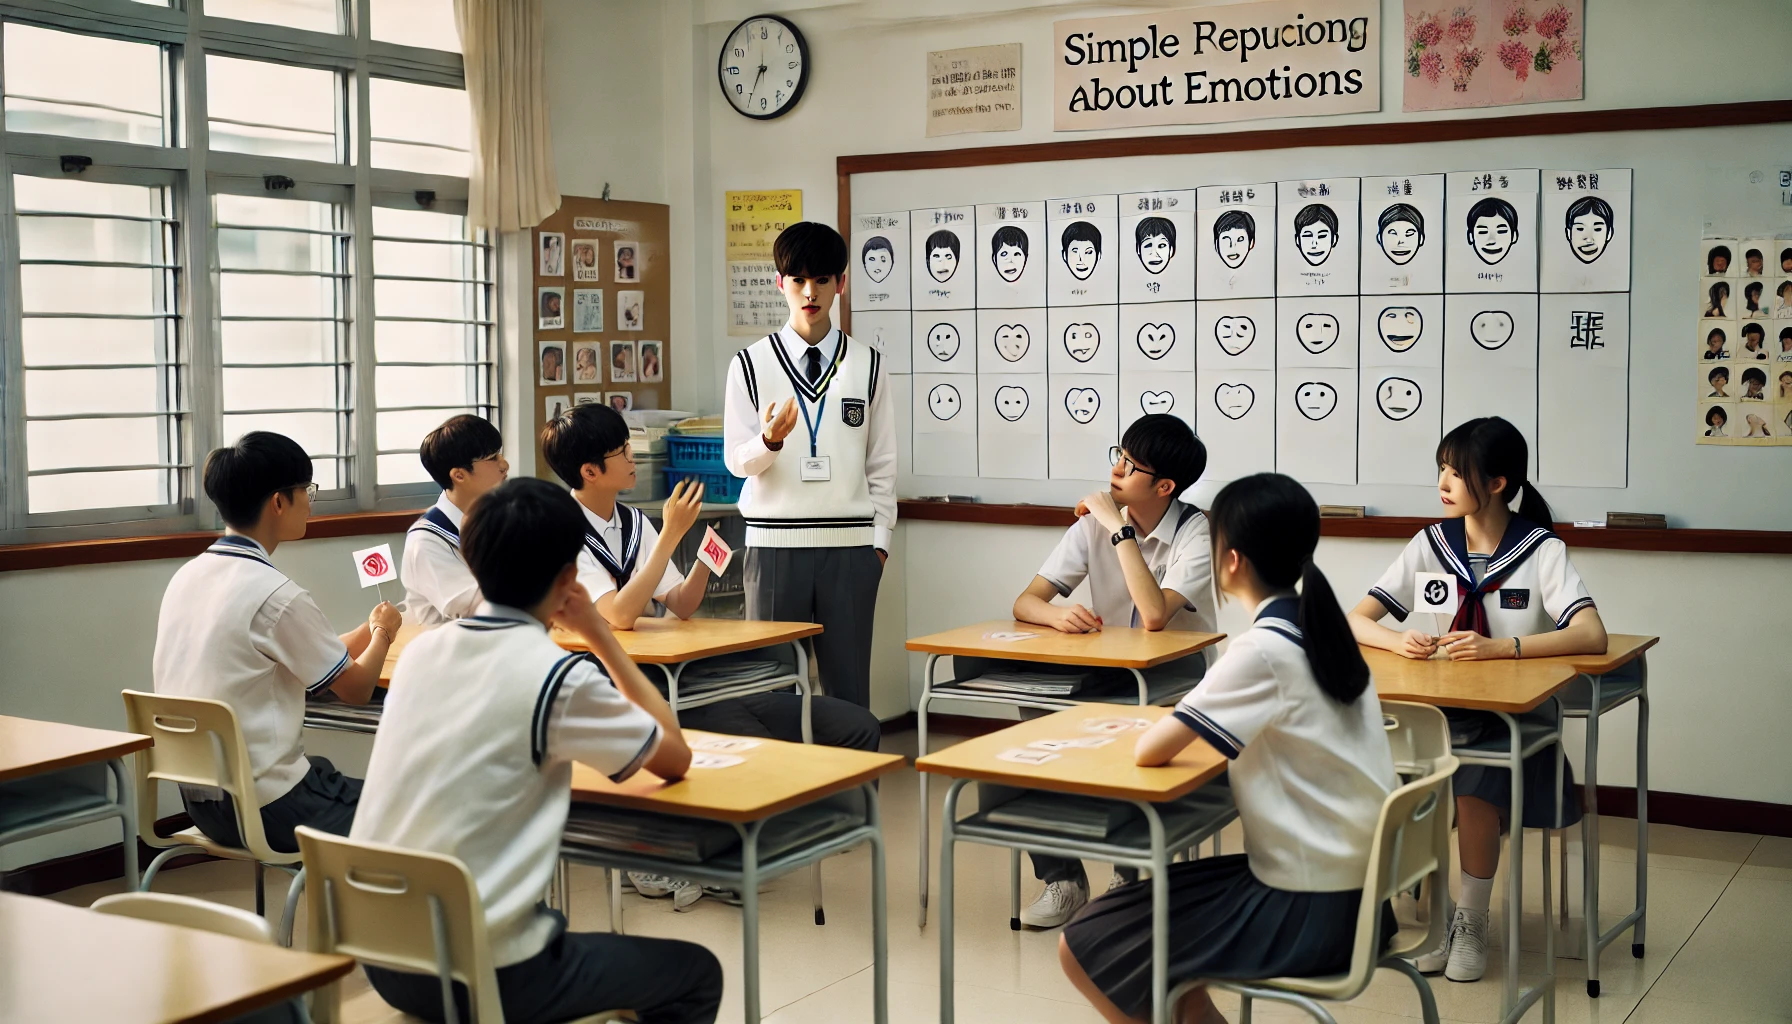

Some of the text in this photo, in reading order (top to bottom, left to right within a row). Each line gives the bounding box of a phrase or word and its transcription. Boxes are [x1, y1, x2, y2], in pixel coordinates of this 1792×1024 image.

[1064, 13, 1369, 73] Simple Repuciong
[1069, 65, 1363, 112] About Emotions
